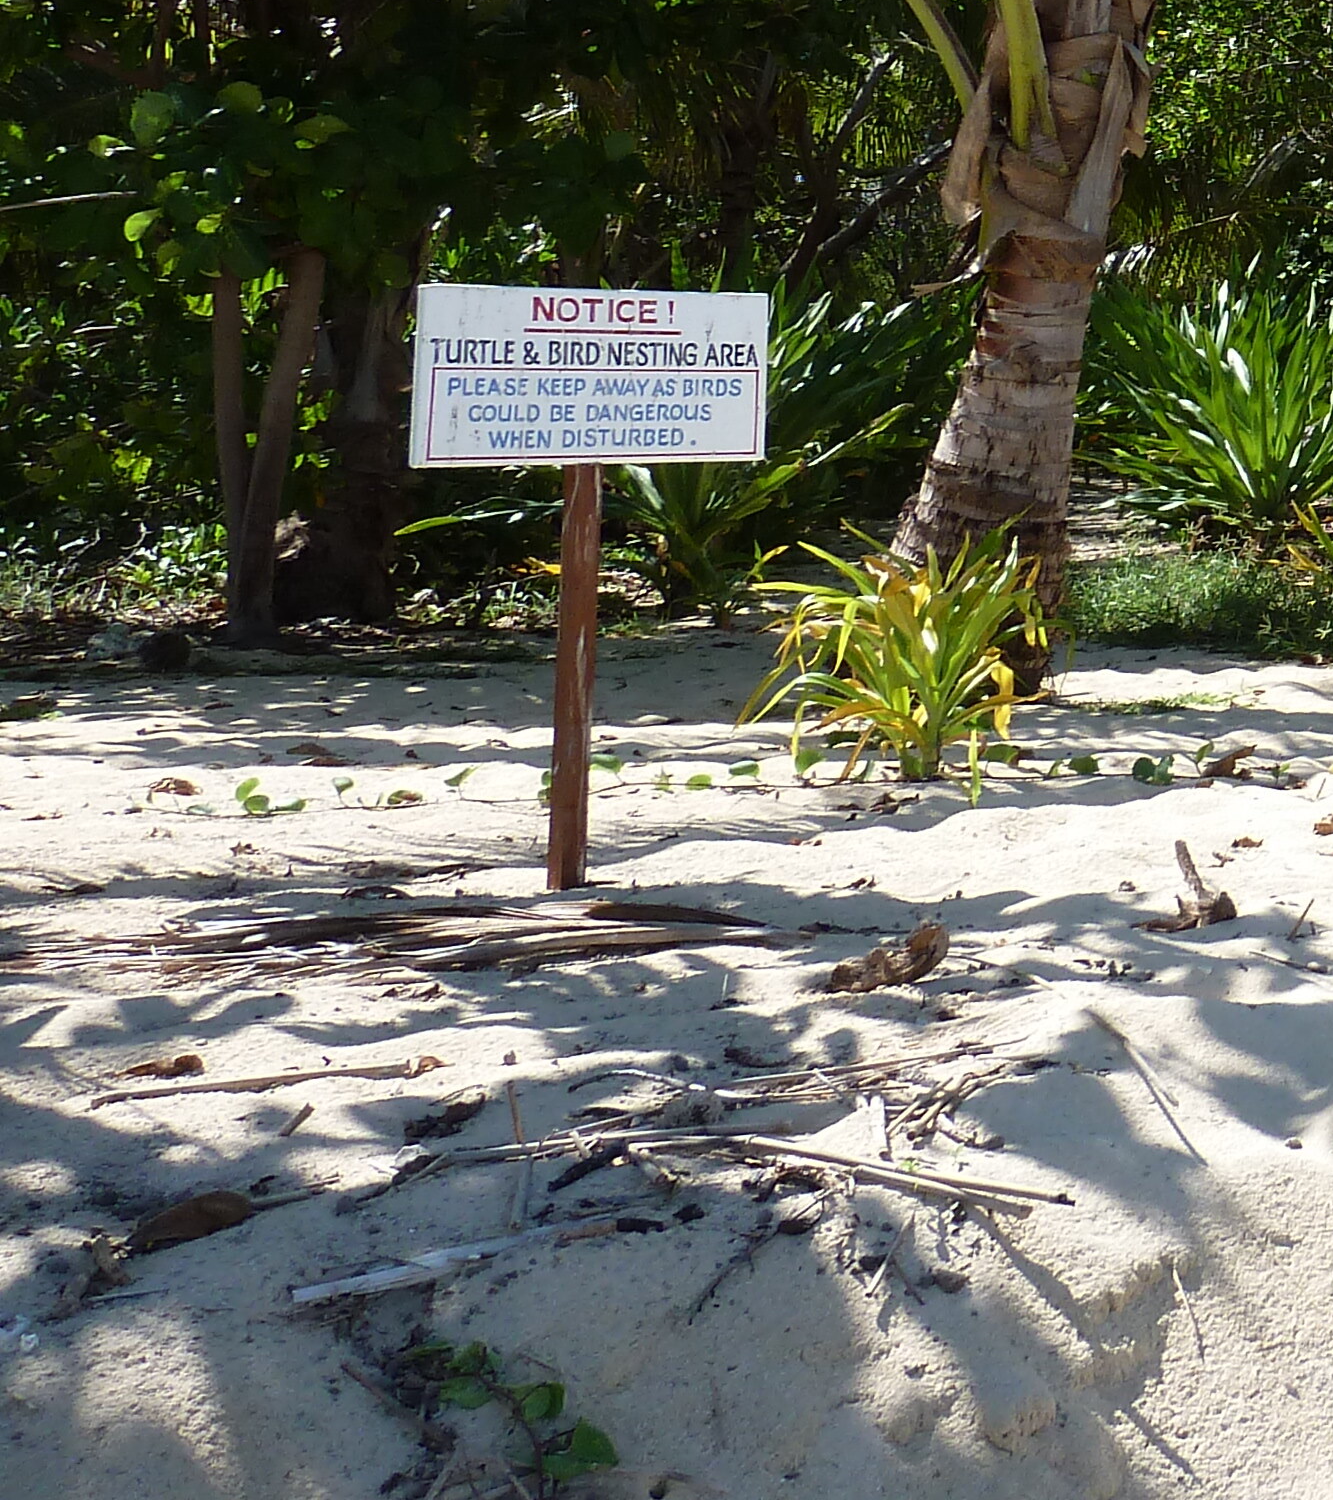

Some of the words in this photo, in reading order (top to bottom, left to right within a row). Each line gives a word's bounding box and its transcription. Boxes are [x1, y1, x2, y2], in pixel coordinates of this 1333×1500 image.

[431, 338, 516, 364] TURTLE
[524, 344, 541, 365] &
[549, 341, 599, 366] BIRD
[607, 342, 697, 367] NESTING
[704, 343, 759, 368] AREA
[447, 377, 528, 396] PLEASE
[537, 378, 586, 397] KEEP
[592, 378, 652, 397] AWAY
[652, 379, 676, 397] AS
[682, 378, 742, 397] BIRDS
[468, 404, 539, 422] COULD
[550, 405, 575, 422] BE
[586, 404, 712, 422] DANGEROUS
[488, 429, 552, 448] WHEN
